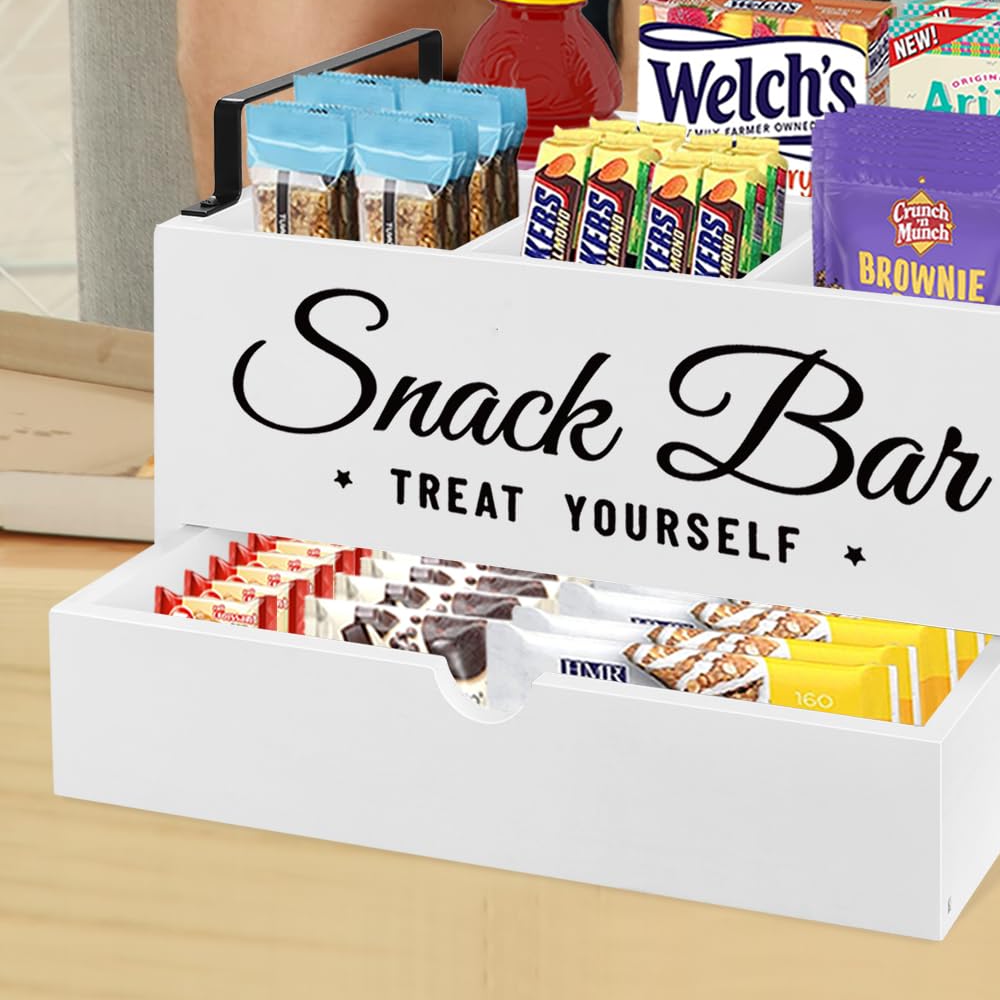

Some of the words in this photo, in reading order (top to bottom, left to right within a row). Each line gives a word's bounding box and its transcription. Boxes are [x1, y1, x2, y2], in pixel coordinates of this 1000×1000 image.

[893, 25, 938, 60] NEW!
[647, 53, 857, 124] Welch's
[725, 123, 770, 136] FARMER
[774, 121, 815, 132] OWNED
[893, 201, 950, 223] Crunch
[896, 222, 950, 244] Munch
[858, 250, 986, 303] BROWNIE
[233, 289, 624, 461] Snack
[657, 344, 993, 513] Bar
[391, 469, 523, 523] TREAT
[565, 494, 800, 564] YOURSELF
[794, 690, 833, 709] 160
